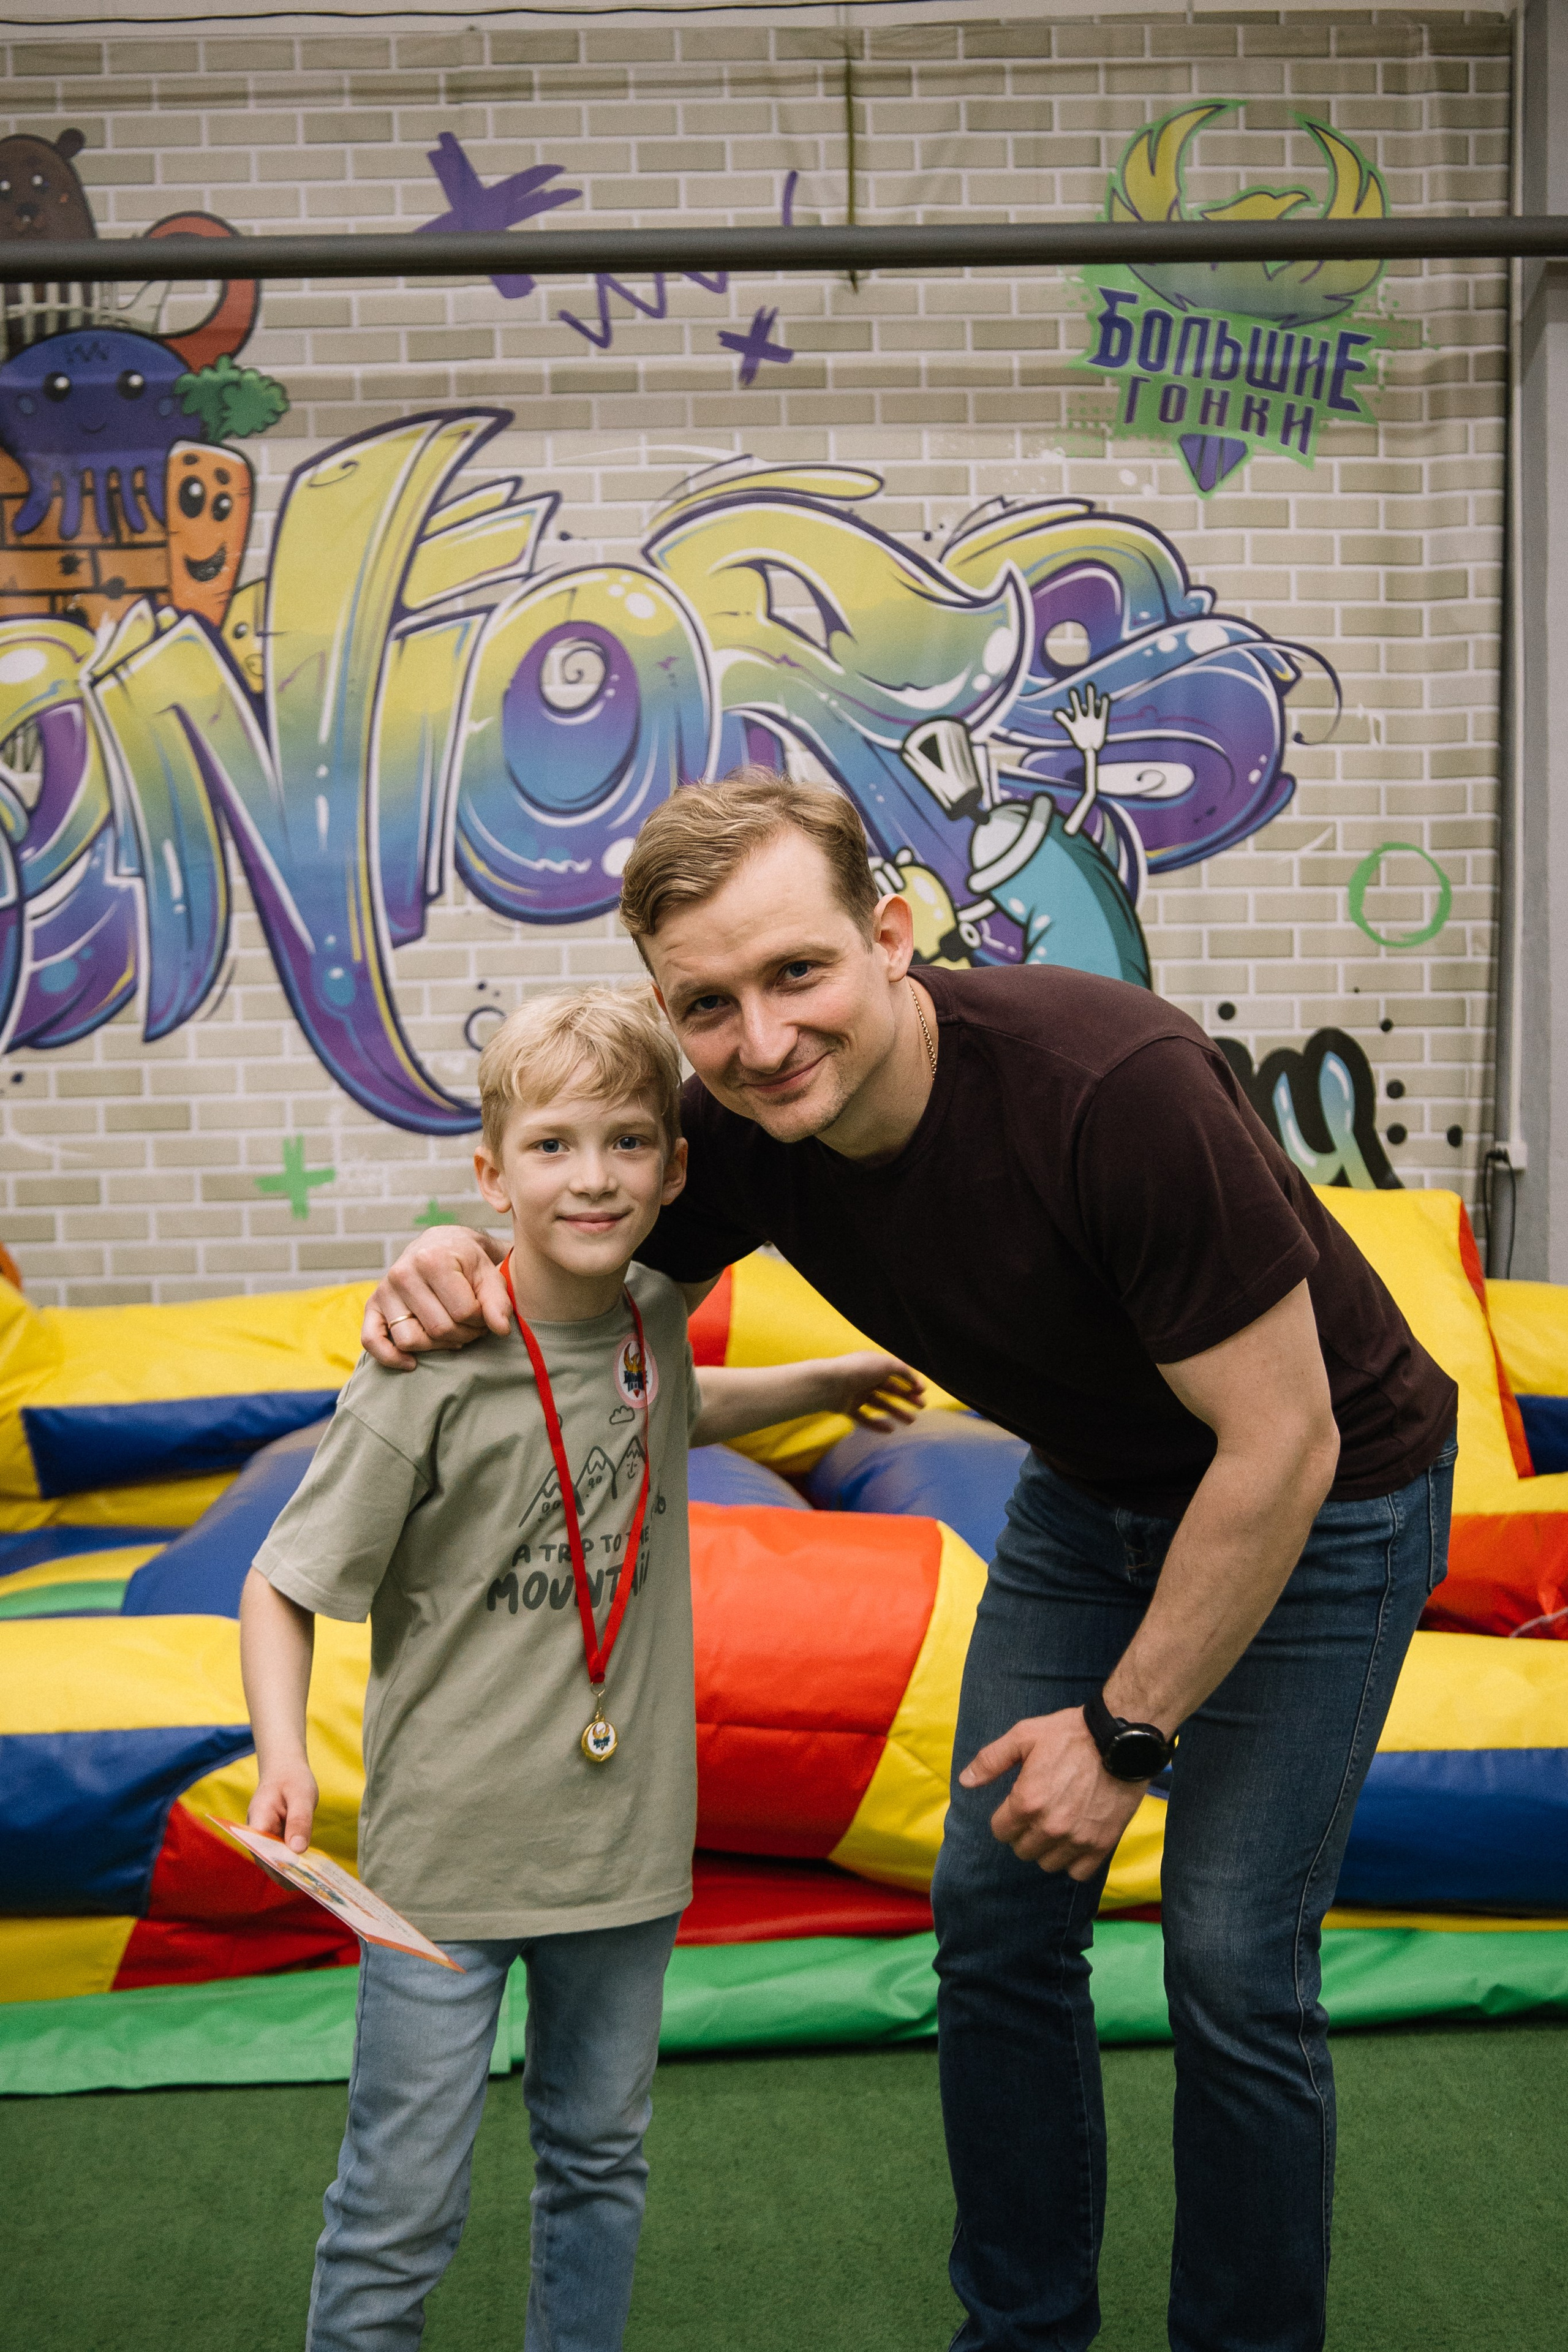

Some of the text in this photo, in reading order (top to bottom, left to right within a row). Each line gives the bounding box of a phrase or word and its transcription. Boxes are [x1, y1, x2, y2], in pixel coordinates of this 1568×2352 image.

[1087, 285, 1375, 413] БОЛЬШИЕ
[1124, 375, 1314, 456] ГОНКИ
[513, 1544, 532, 1566] A
[539, 1537, 594, 1563] TRP
[601, 1534, 622, 1553] TO
